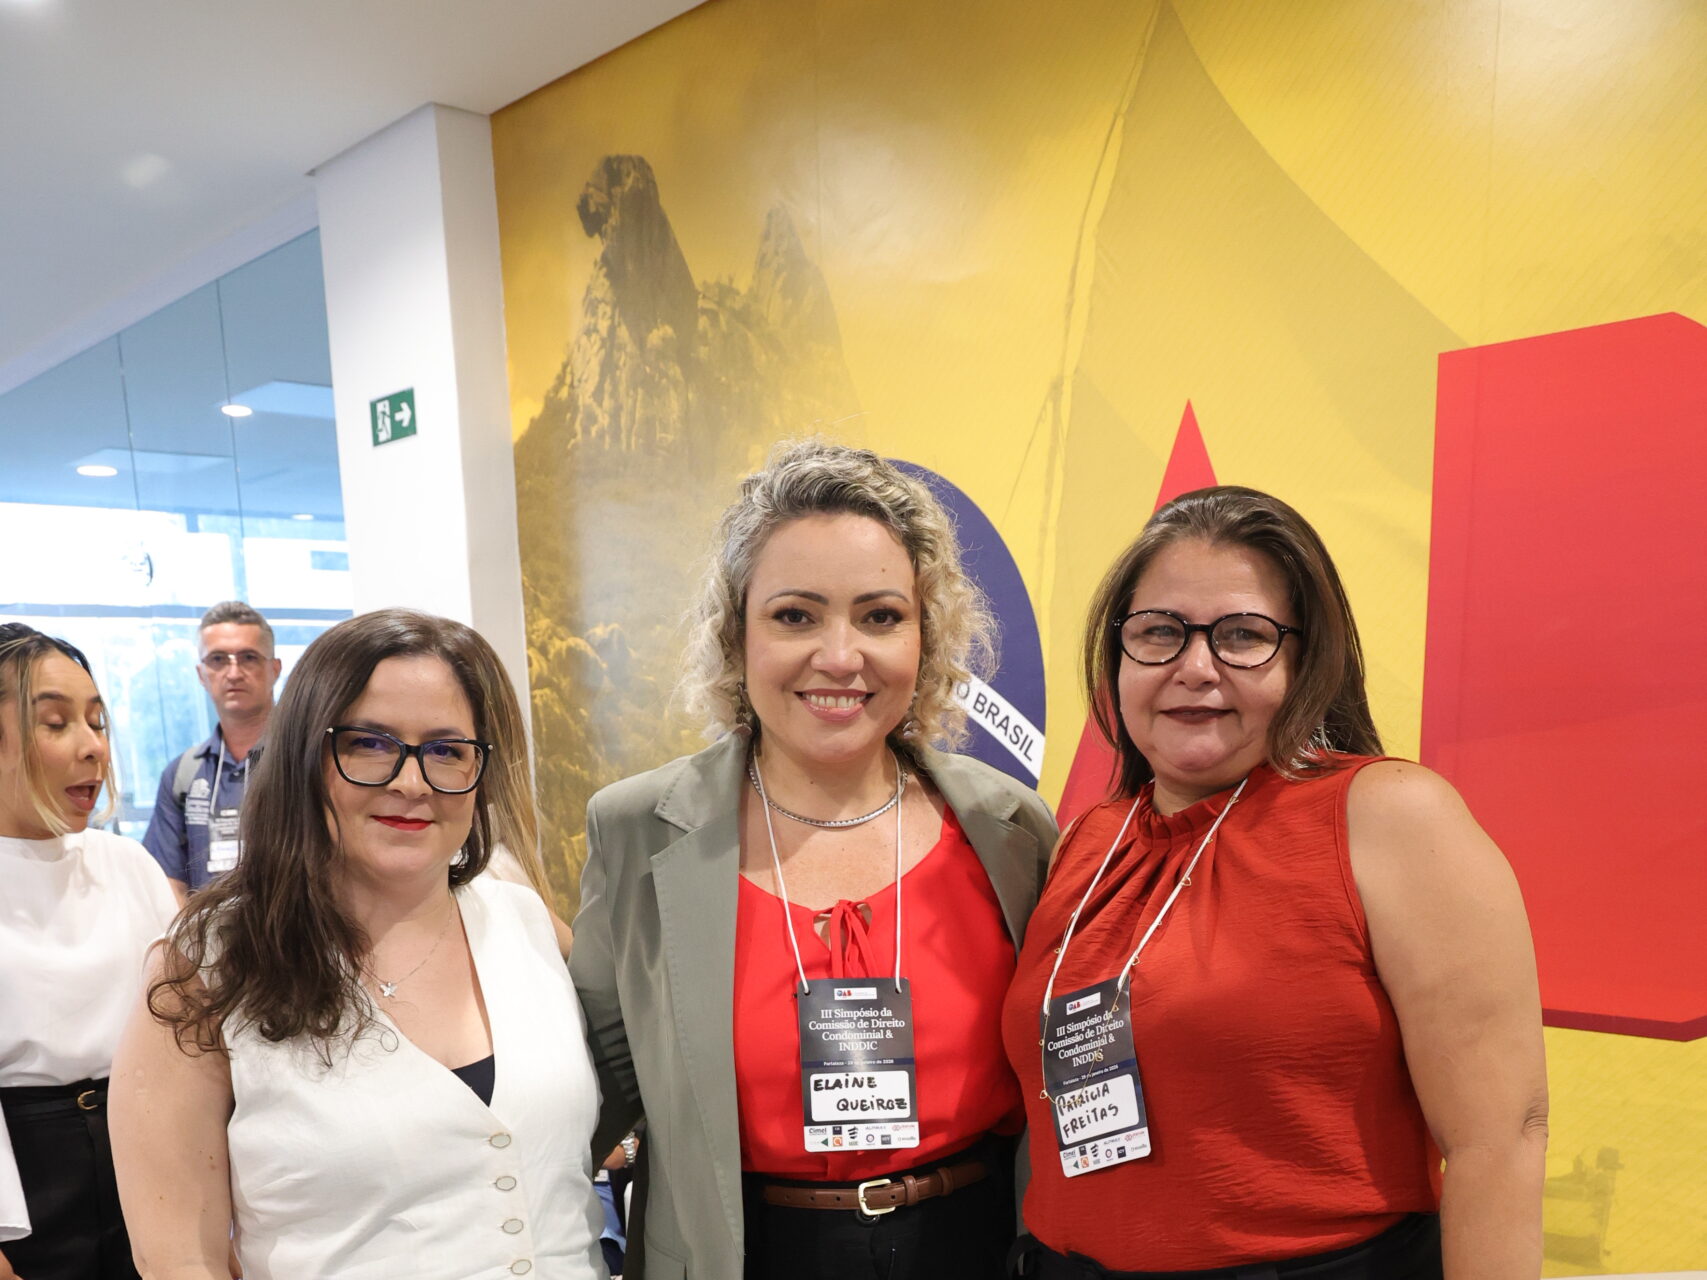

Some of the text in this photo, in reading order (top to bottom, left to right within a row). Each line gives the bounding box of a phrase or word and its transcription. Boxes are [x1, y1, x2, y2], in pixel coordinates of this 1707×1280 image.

[973, 692, 1034, 762] BRASIL
[821, 1007, 893, 1020] III Simpósio da
[808, 1018, 905, 1030] Comissão de Direito
[1056, 1025, 1066, 1037] III
[1066, 1014, 1102, 1034] Simpósio
[822, 1030, 893, 1041] Condominial &
[1047, 1019, 1124, 1051] Comissão de Direito
[839, 1041, 878, 1052] INDDIC
[1058, 1033, 1116, 1060] Condominial &
[813, 1073, 877, 1091] ELAINE
[836, 1095, 907, 1111] QUEIROZ
[1063, 1103, 1119, 1138] FREITAS
